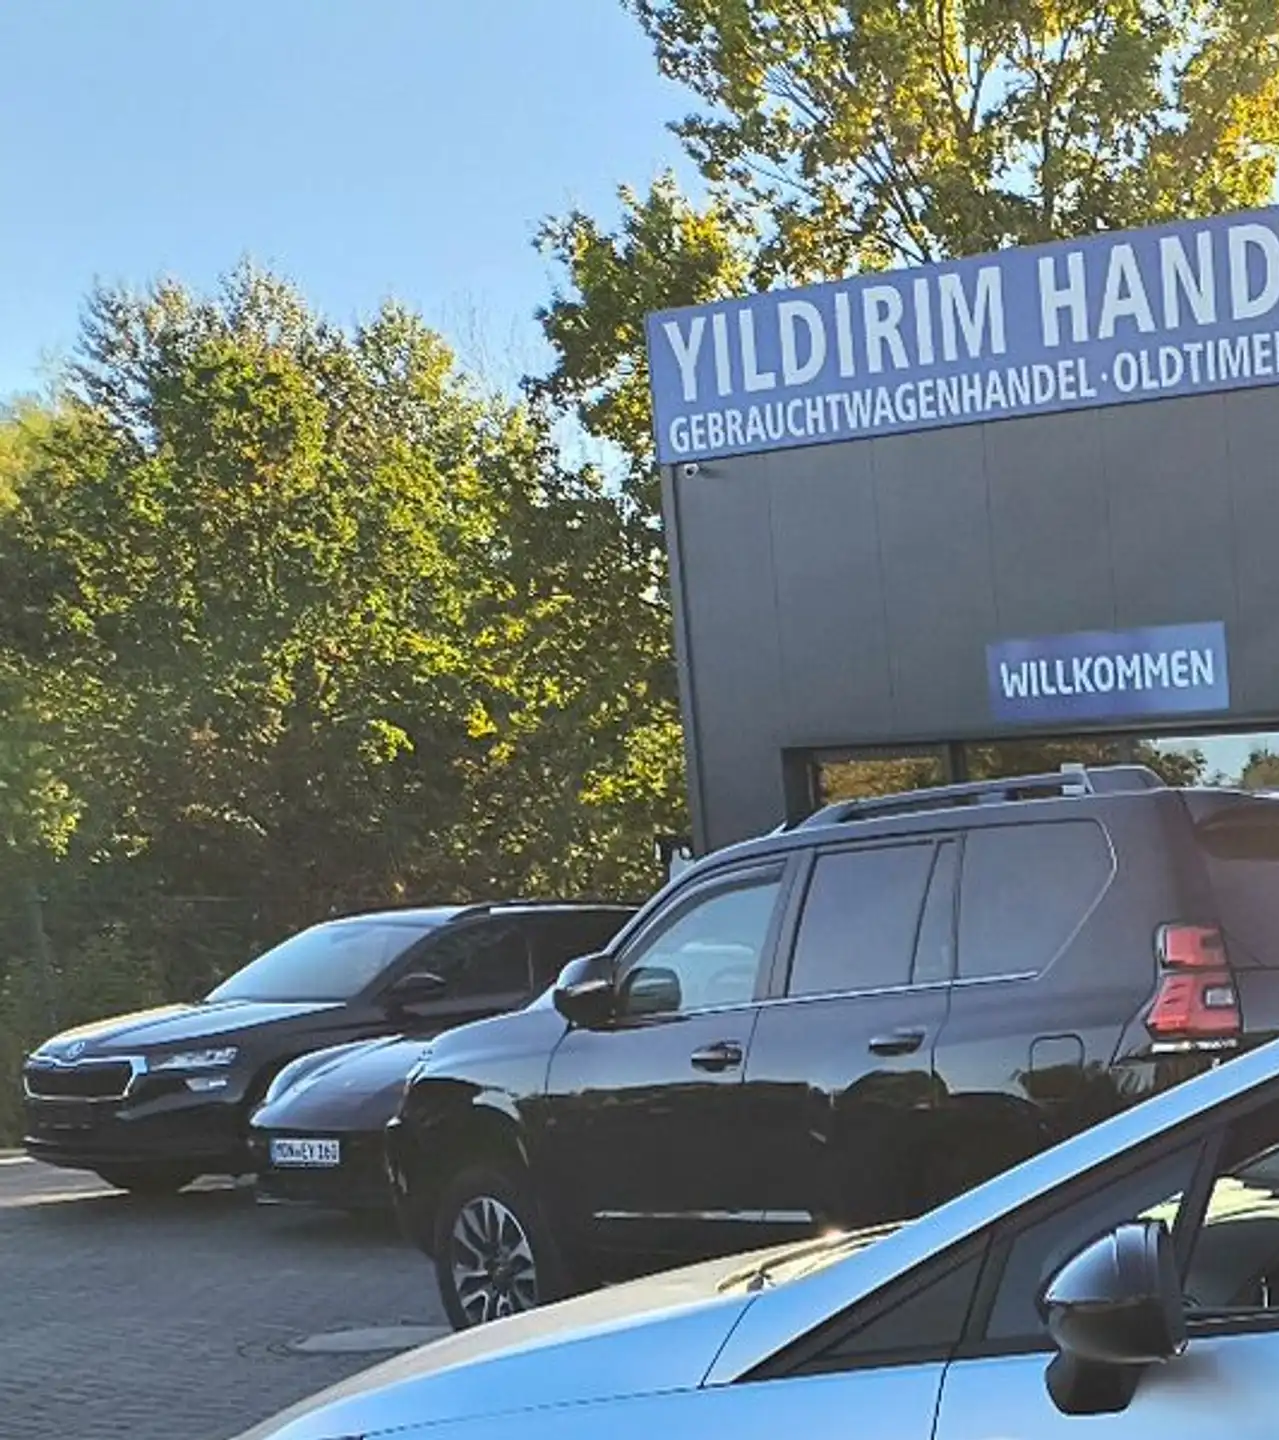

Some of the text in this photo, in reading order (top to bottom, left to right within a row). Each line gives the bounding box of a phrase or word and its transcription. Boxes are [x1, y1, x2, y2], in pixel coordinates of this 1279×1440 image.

[662, 266, 1006, 403] YILDIRIM
[669, 356, 1097, 454] GEBRAUCHTWAGENHANDEL
[999, 648, 1215, 698] WILLKOMMEN
